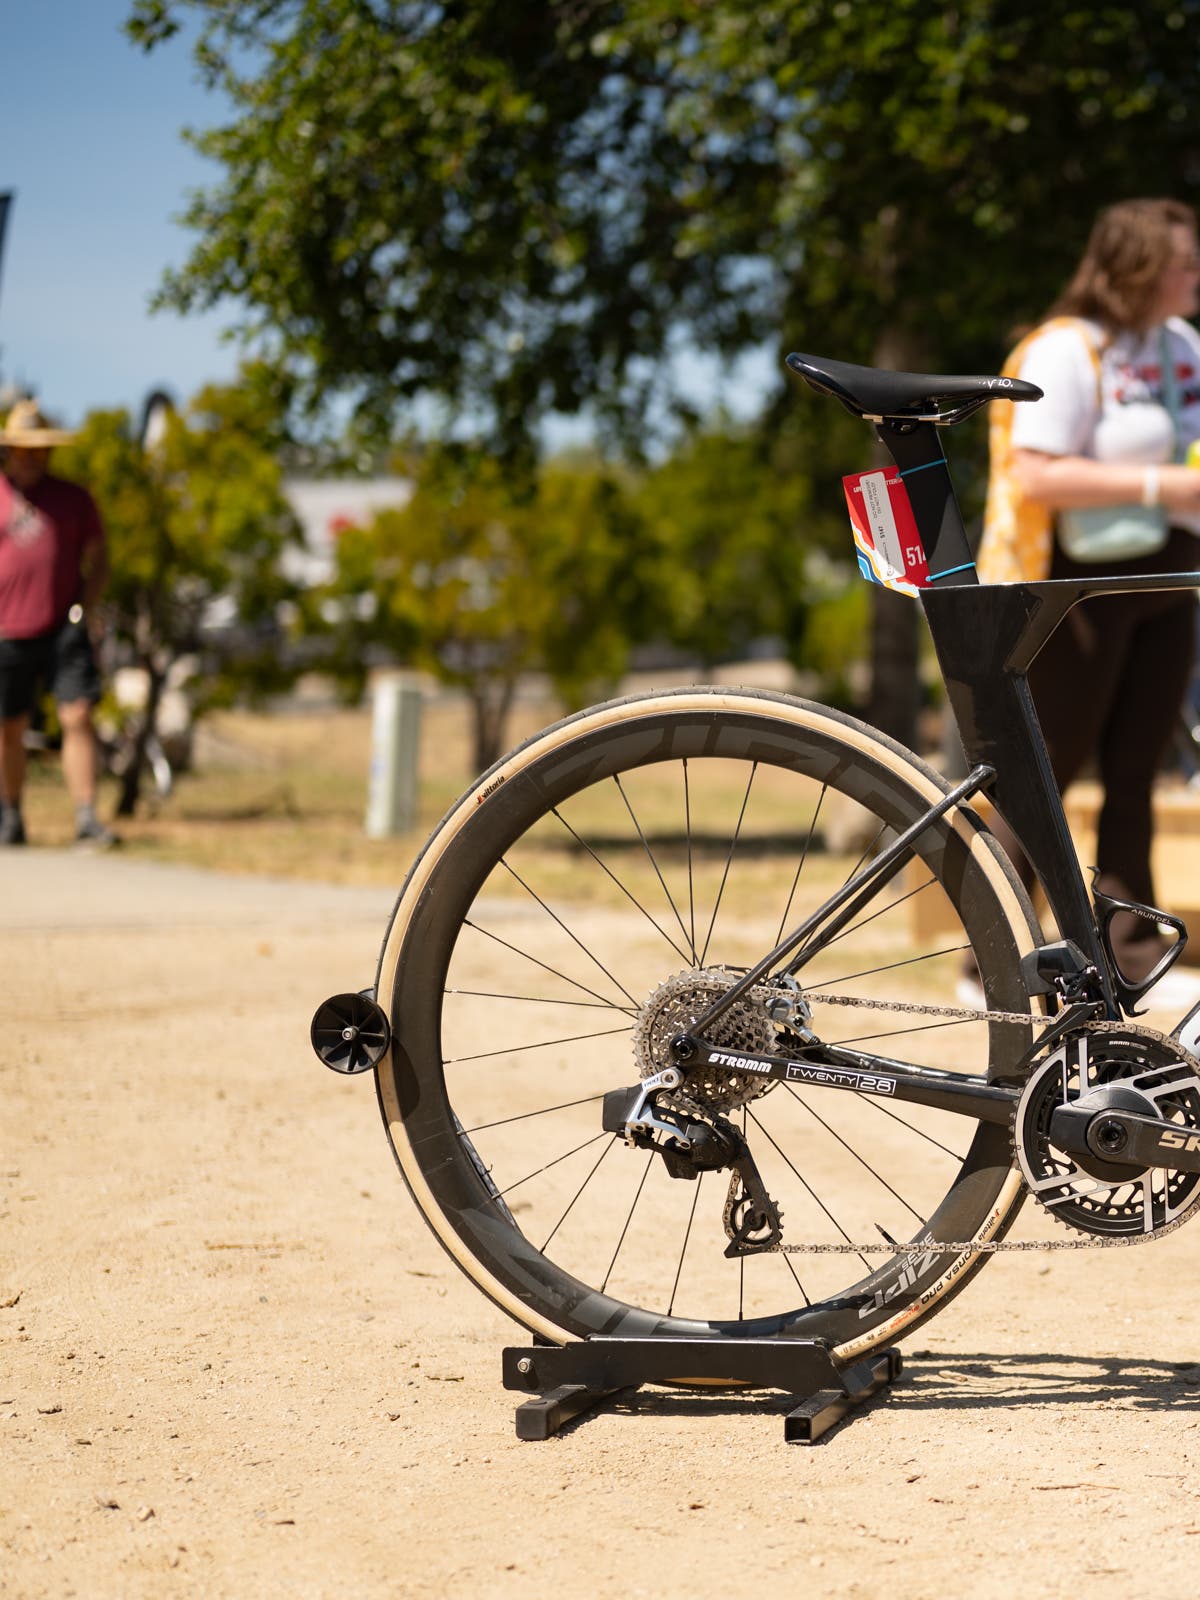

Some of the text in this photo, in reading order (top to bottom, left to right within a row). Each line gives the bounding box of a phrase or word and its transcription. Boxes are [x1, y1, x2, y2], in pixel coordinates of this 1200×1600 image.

[1131, 908, 1172, 925] ARUNDEL
[708, 1052, 772, 1073] STROMM
[790, 1067, 892, 1092] TWENTY 28
[858, 1252, 940, 1320] ZIPP
[921, 1245, 975, 1305] ORSA PRO
